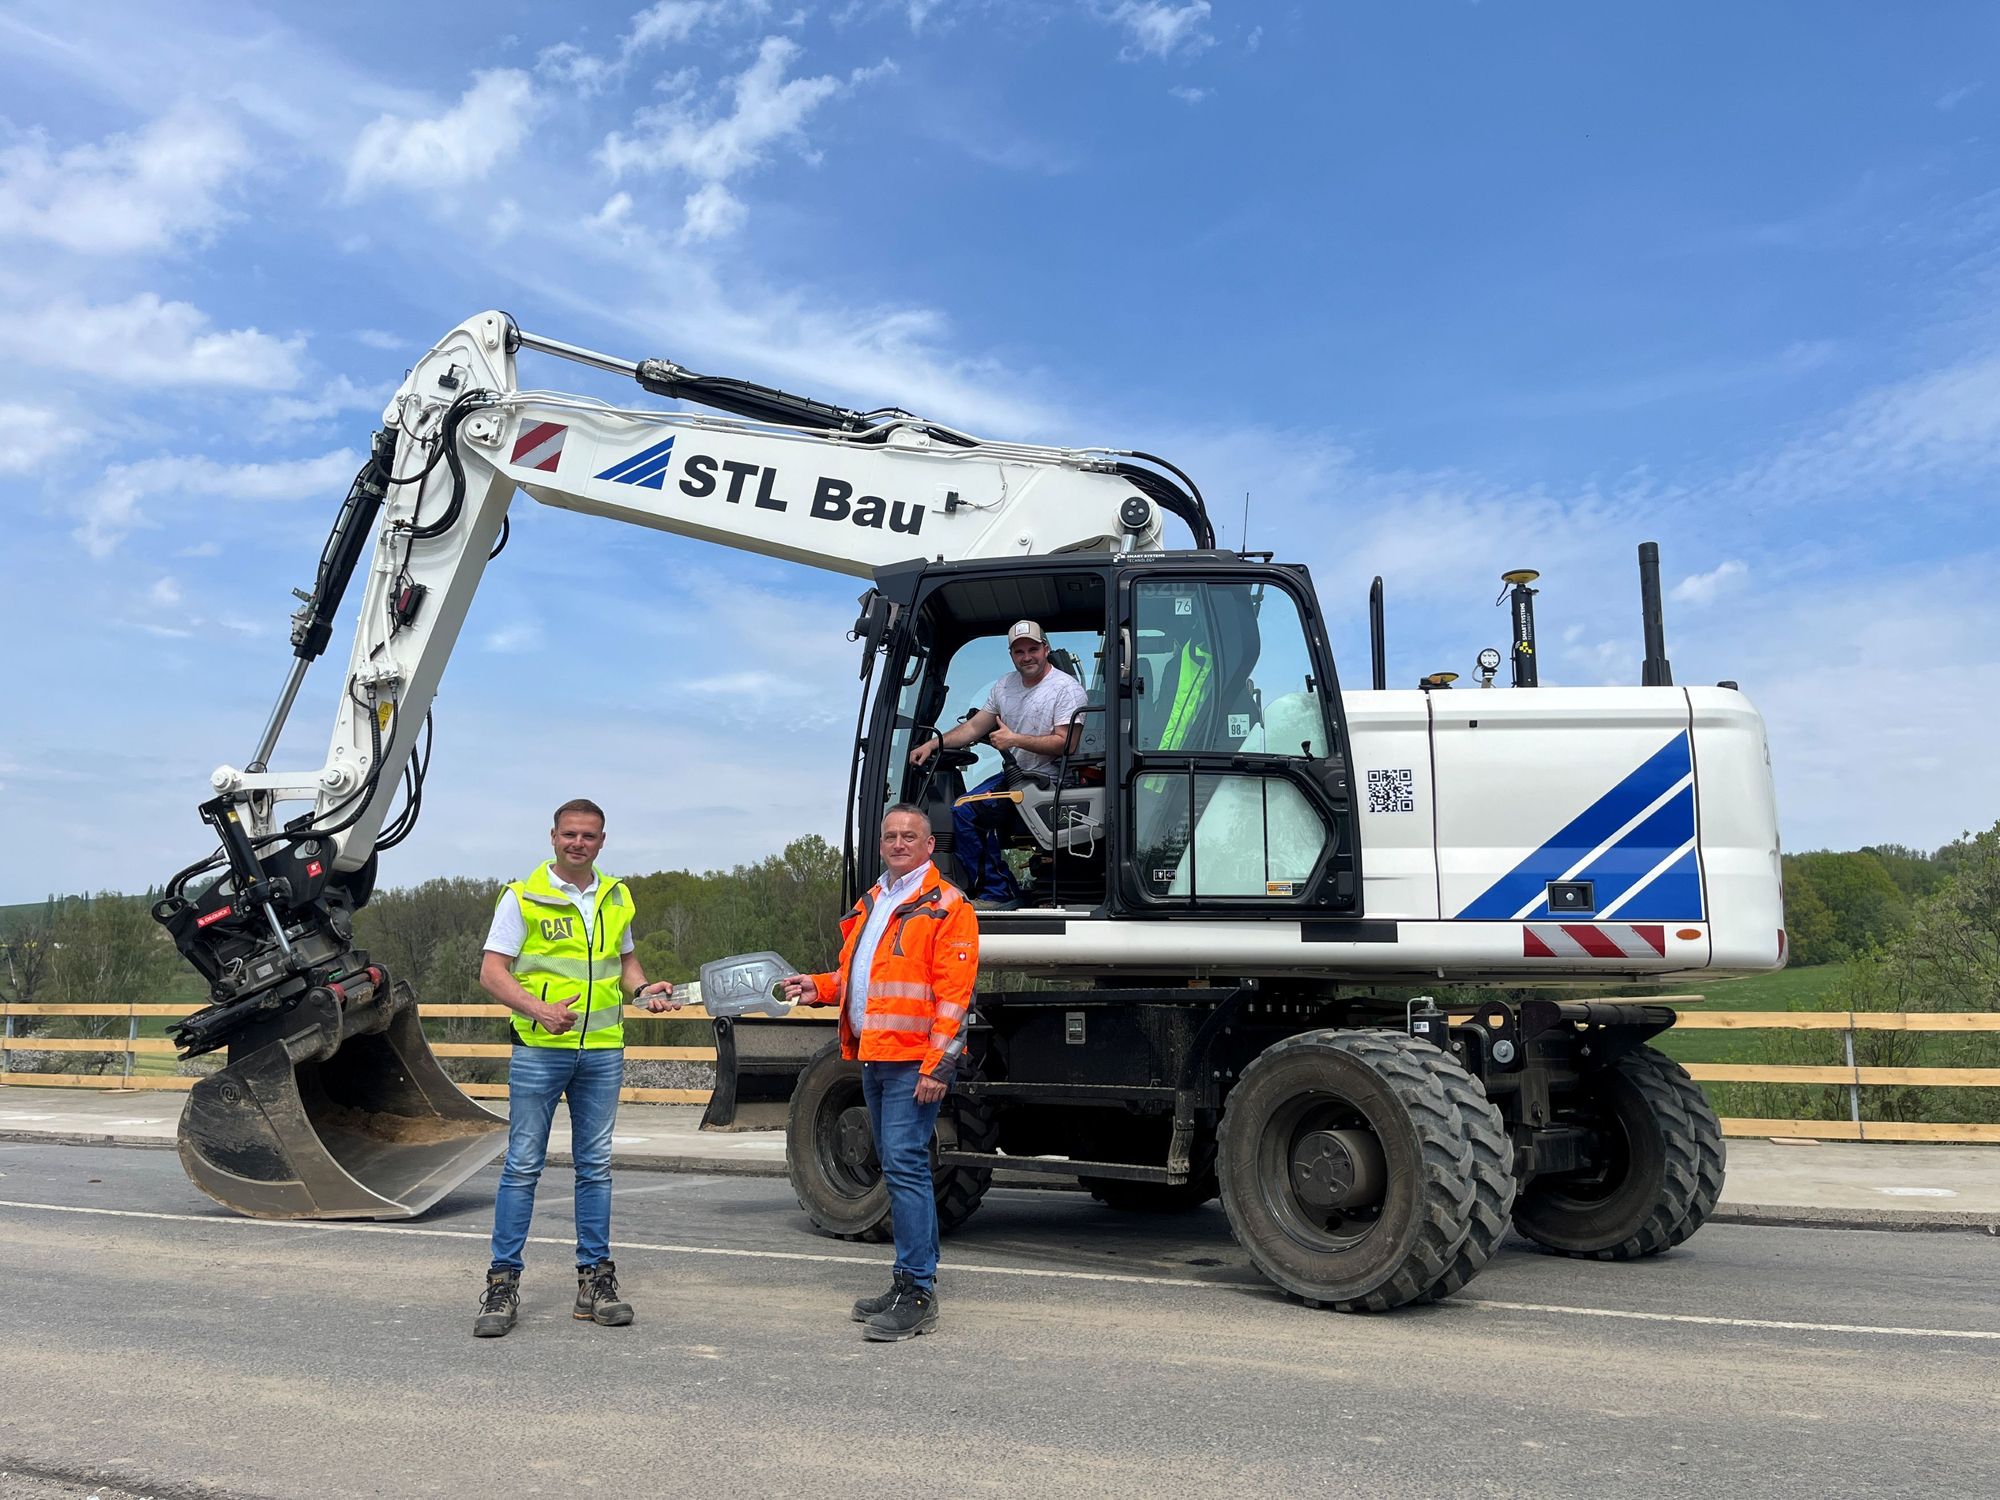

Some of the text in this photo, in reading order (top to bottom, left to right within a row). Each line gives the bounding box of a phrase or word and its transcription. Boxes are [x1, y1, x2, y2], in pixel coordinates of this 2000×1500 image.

[679, 454, 926, 535] STL Bau
[1176, 600, 1191, 613] 76
[1231, 723, 1241, 736] 98
[540, 916, 573, 941] CAT
[711, 966, 763, 1000] CAT
